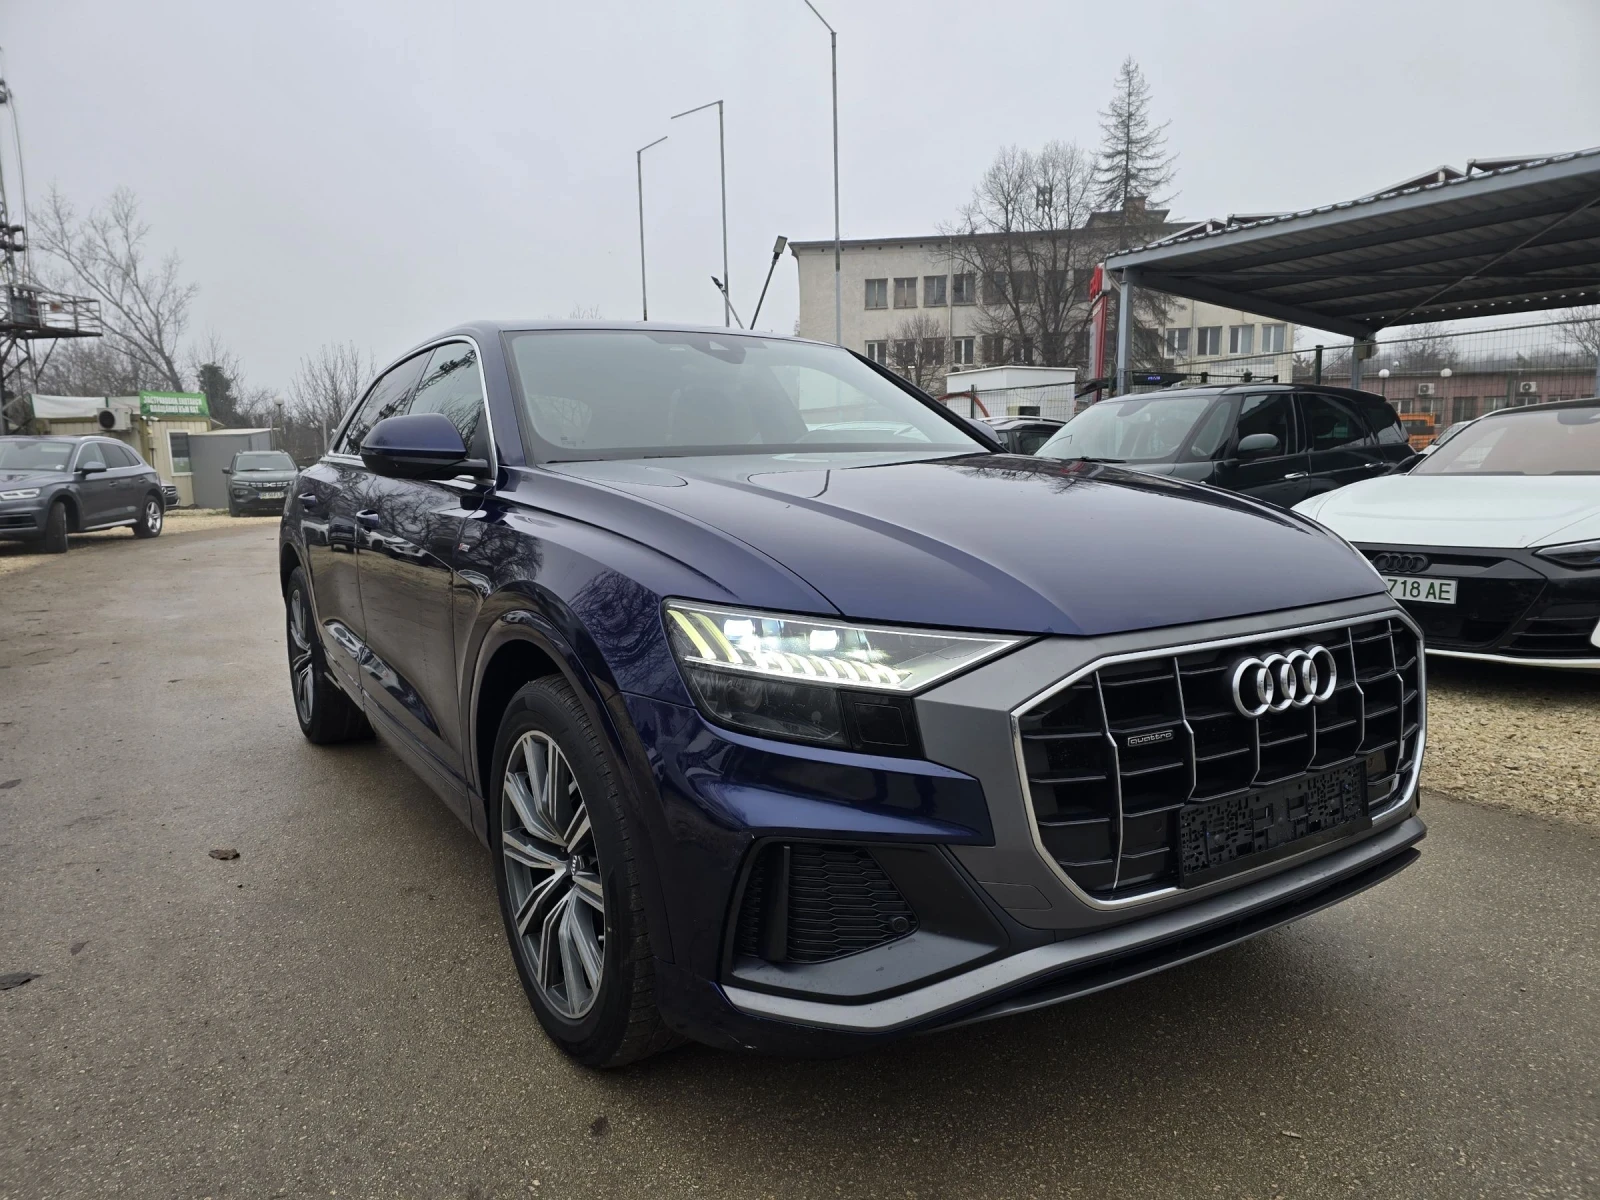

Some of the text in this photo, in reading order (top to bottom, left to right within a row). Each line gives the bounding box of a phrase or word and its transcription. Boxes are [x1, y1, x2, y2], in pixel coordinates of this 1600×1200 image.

[1387, 578, 1452, 601] 718 AE
[1129, 731, 1173, 746] quattro
